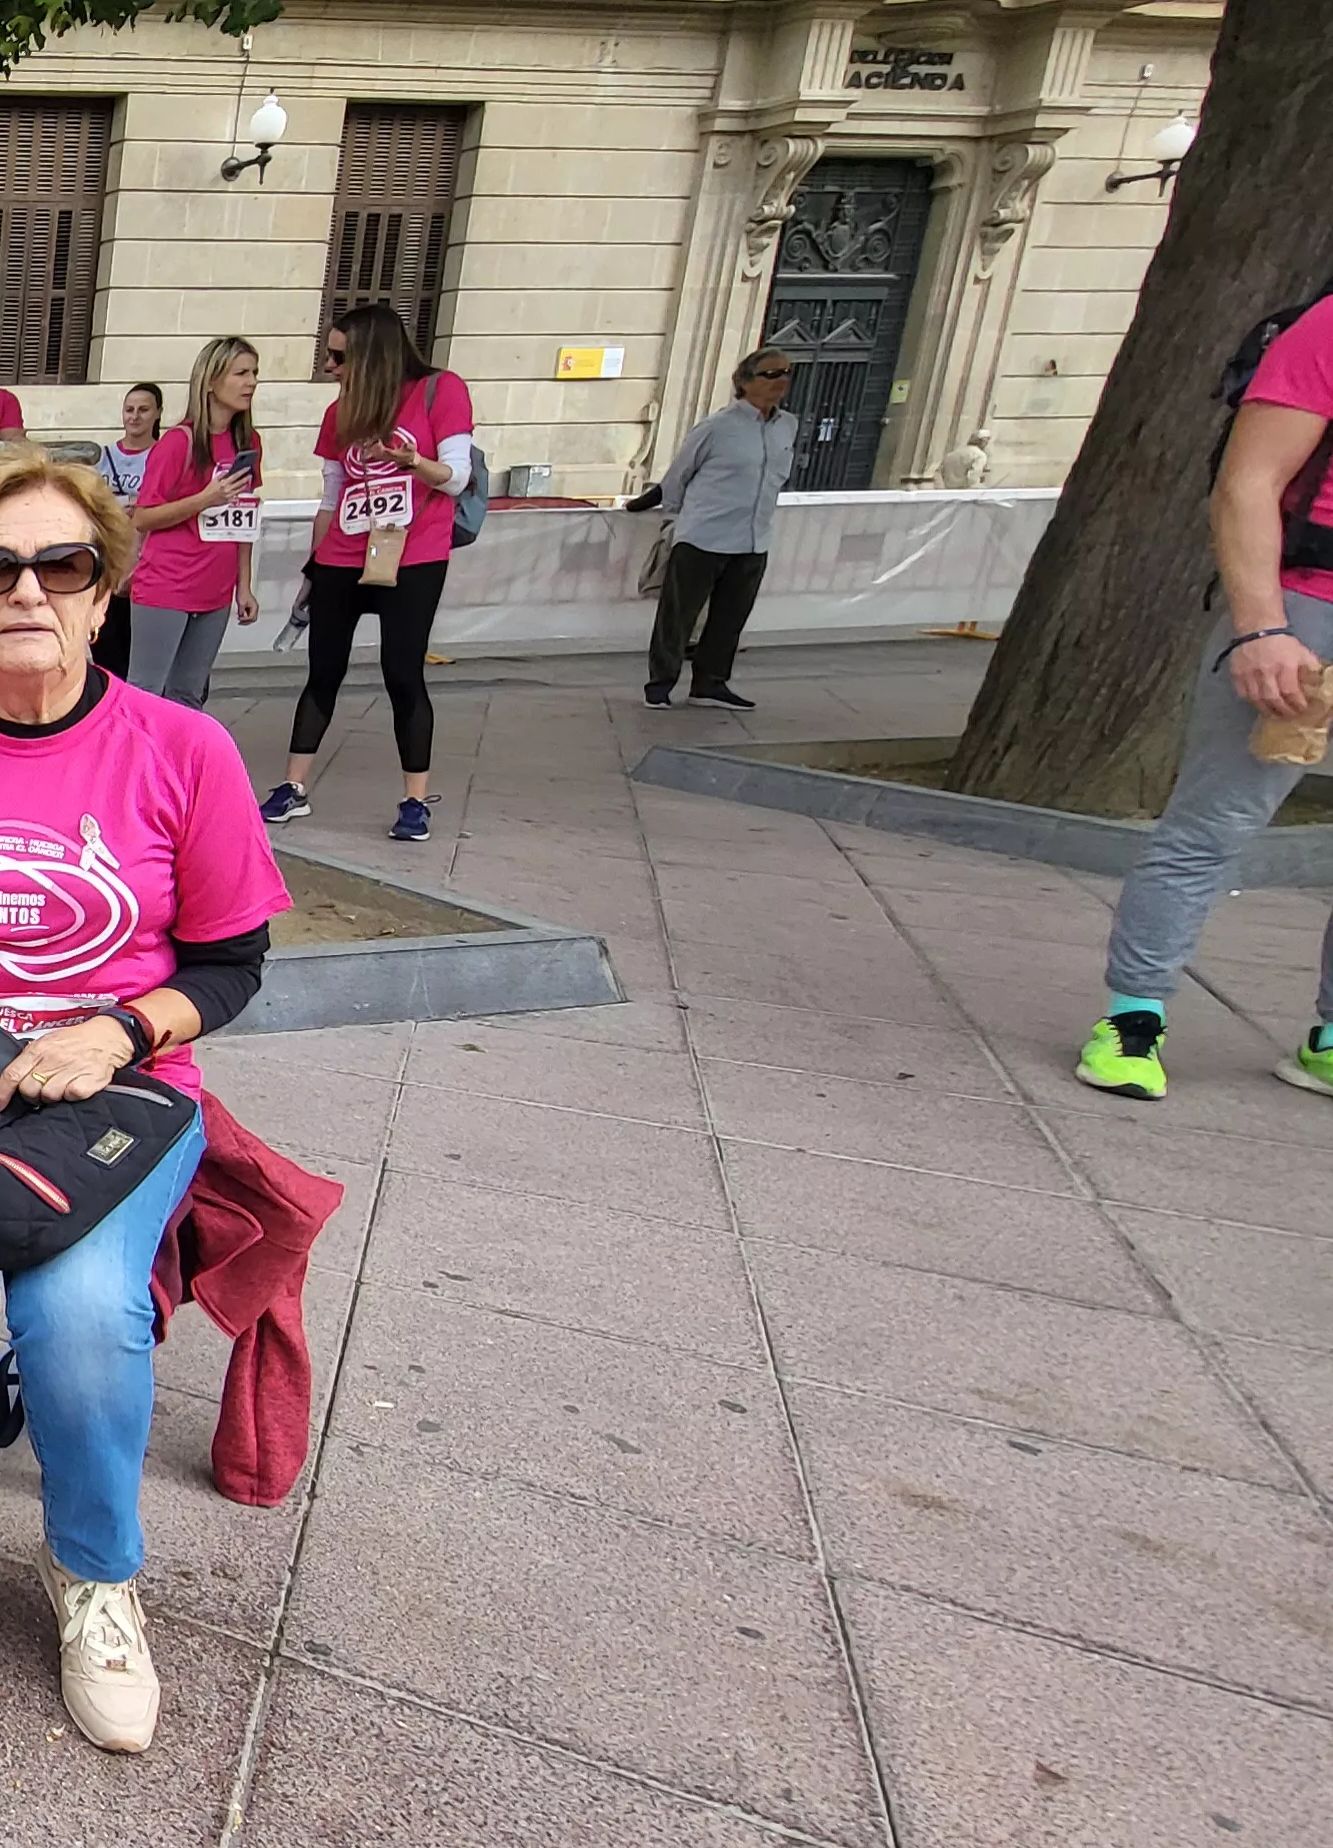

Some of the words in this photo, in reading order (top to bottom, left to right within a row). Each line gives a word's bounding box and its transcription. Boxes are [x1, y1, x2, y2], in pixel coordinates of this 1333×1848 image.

[844, 71, 965, 91] ACIENDA
[346, 494, 404, 521] 2492
[206, 509, 254, 528] 3181
[0, 1018, 17, 1032] EL
